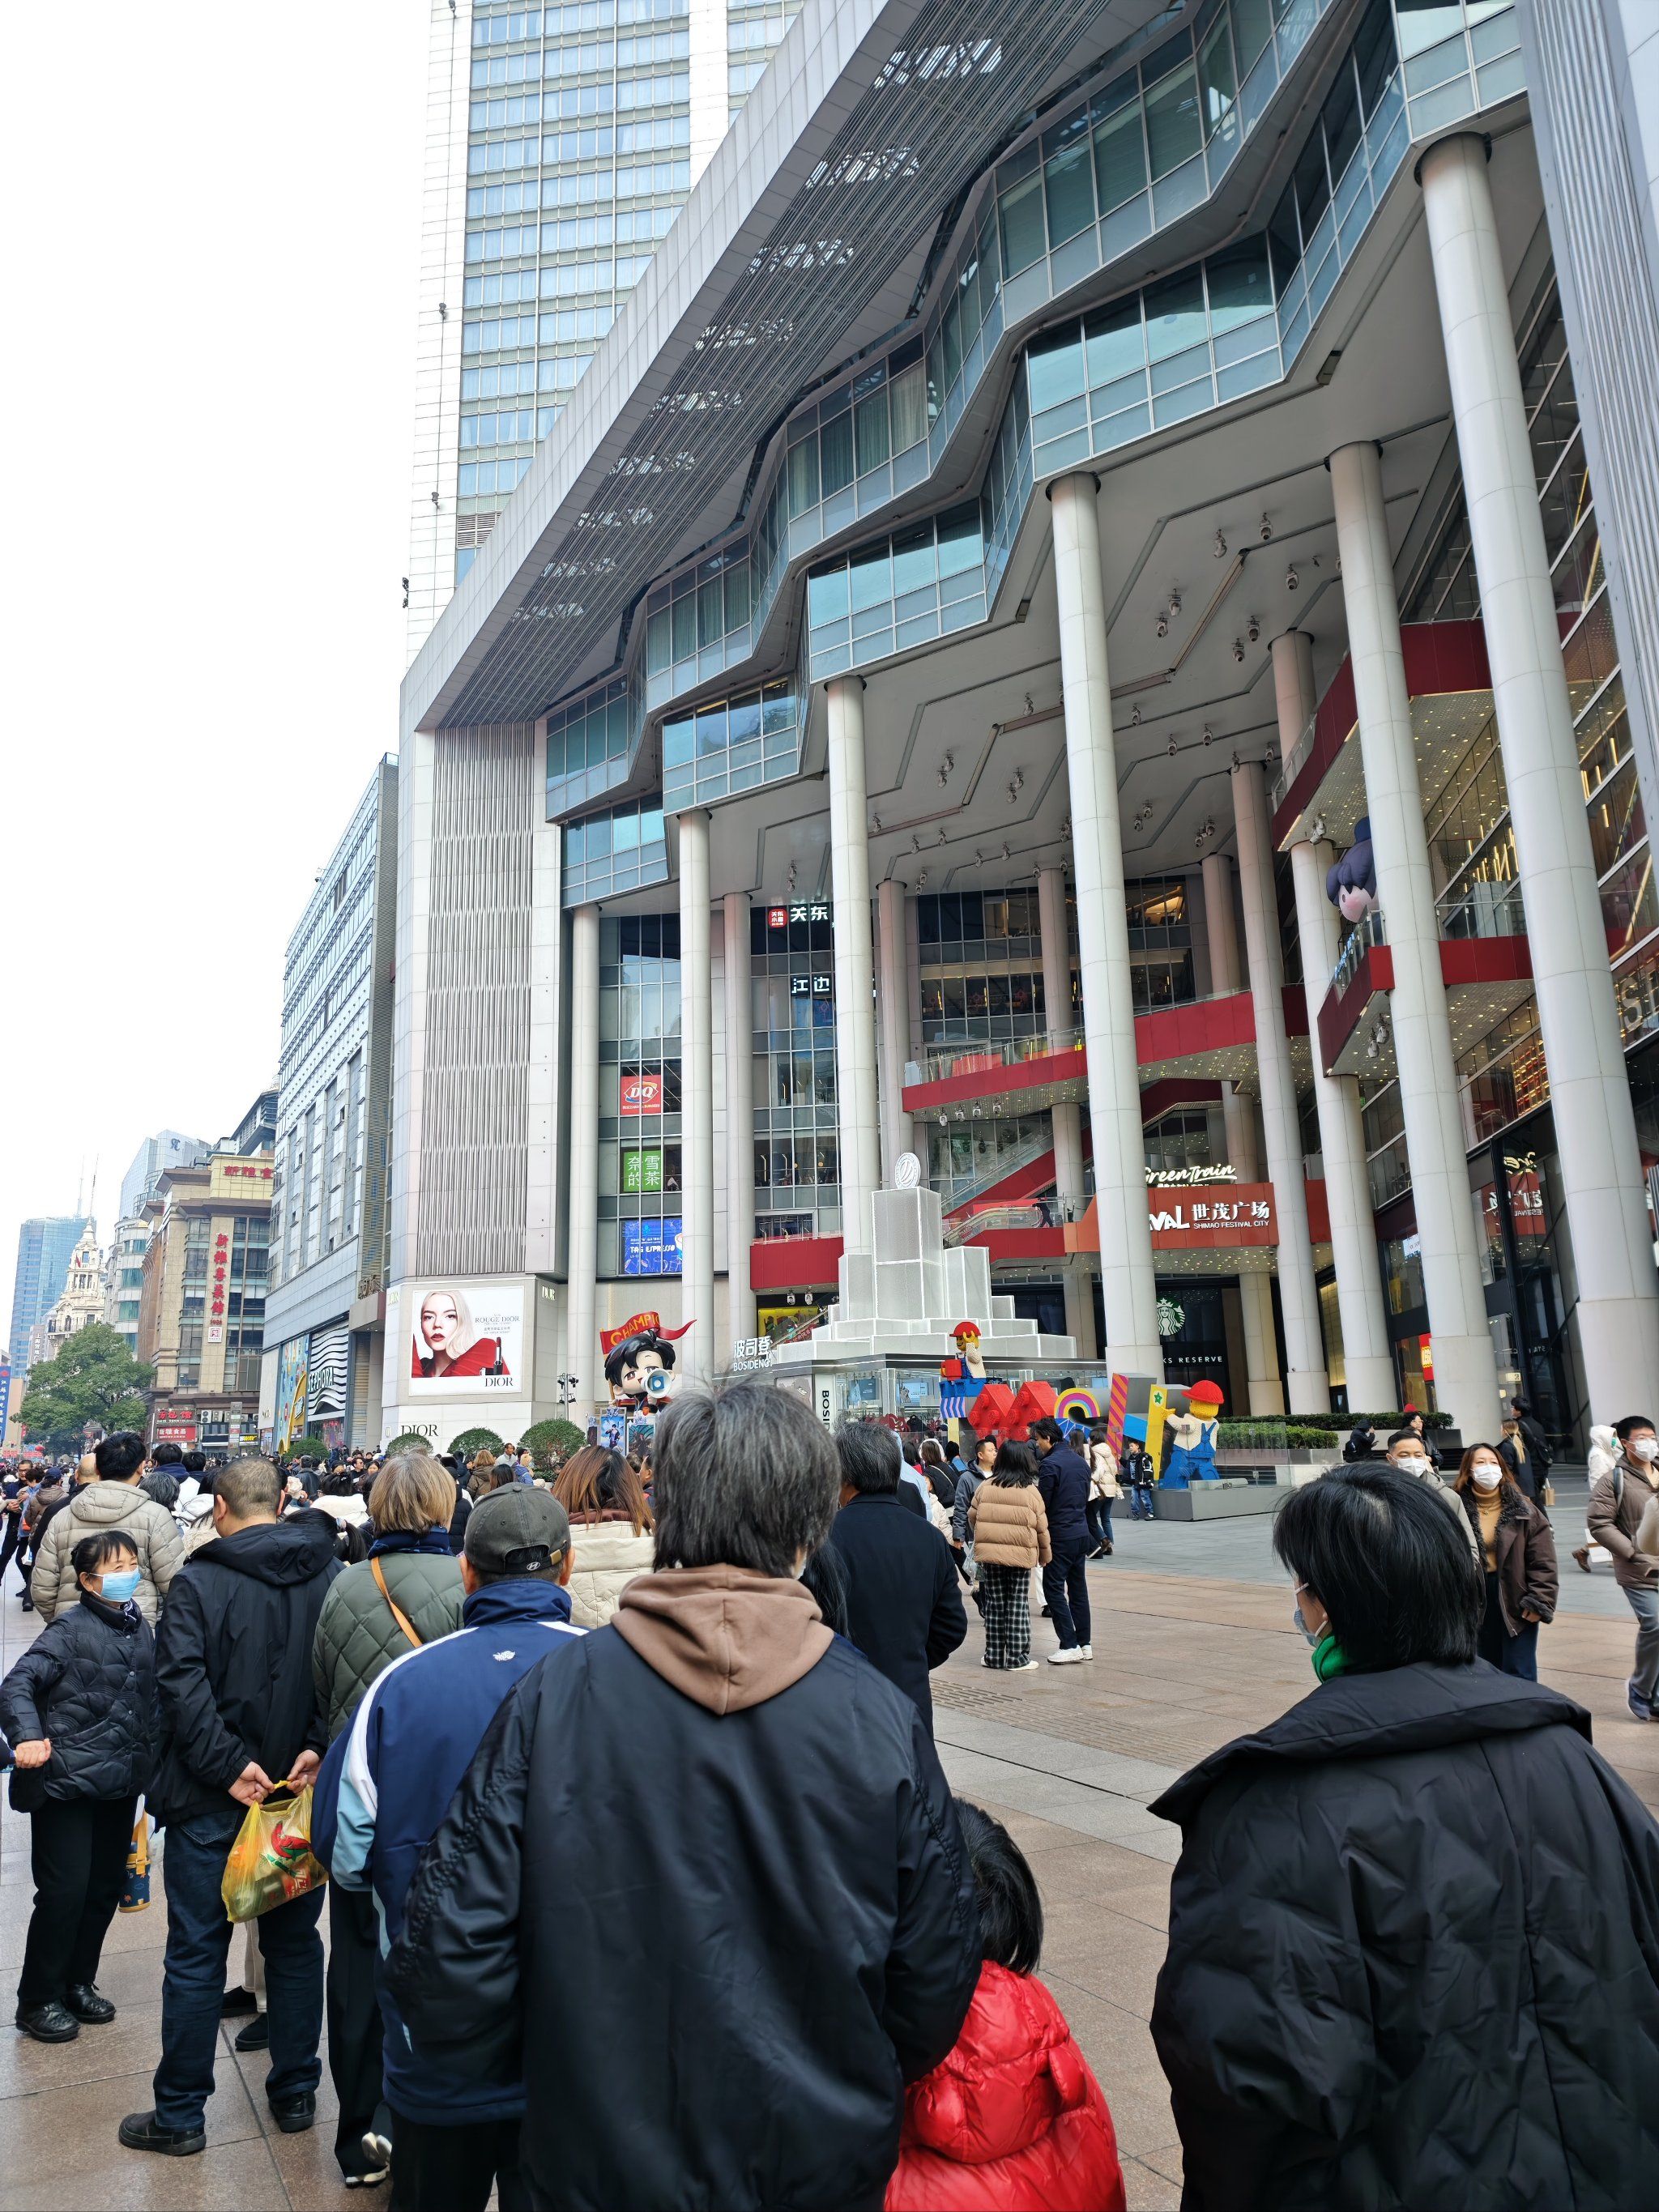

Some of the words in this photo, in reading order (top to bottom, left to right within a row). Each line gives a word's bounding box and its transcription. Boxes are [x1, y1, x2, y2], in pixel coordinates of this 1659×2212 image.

[791, 976, 830, 994] 江边
[630, 1086, 654, 1099] DQ
[628, 1155, 660, 1171] 奈雪
[628, 1171, 660, 1187] 的茶
[1191, 1200, 1270, 1221] 世茂广场
[1222, 1221, 1252, 1229] FESTIVAL
[734, 1335, 773, 1359] 波司登
[733, 1359, 772, 1372] BOSIDENG
[308, 1366, 333, 1392] SEPHORA
[485, 1377, 514, 1387] DIOR
[401, 1424, 439, 1437] DIOR
